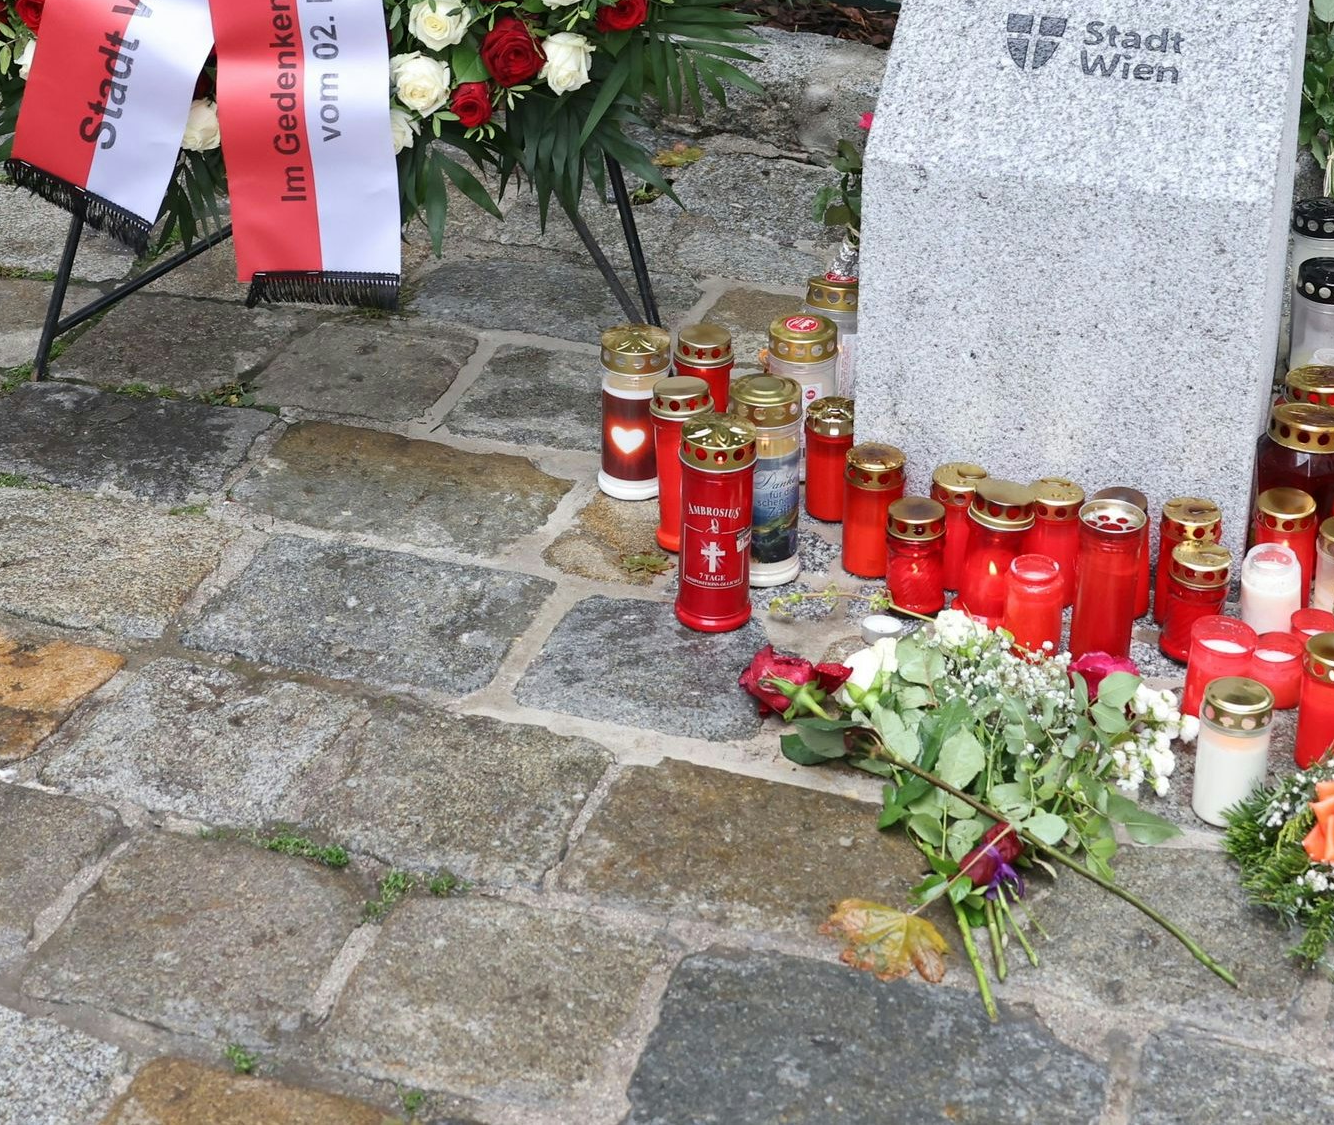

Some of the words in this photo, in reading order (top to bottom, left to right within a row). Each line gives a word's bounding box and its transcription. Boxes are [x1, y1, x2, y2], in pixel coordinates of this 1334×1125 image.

[310, 16, 339, 60] 02.
[1083, 21, 1185, 55] Stadt
[1081, 50, 1179, 83] Wien
[79, 31, 140, 150] Stadt
[320, 73, 341, 142] vom
[281, 166, 307, 202] Im
[688, 502, 741, 519] AMBROSIUS
[704, 574, 727, 582] TAGE
